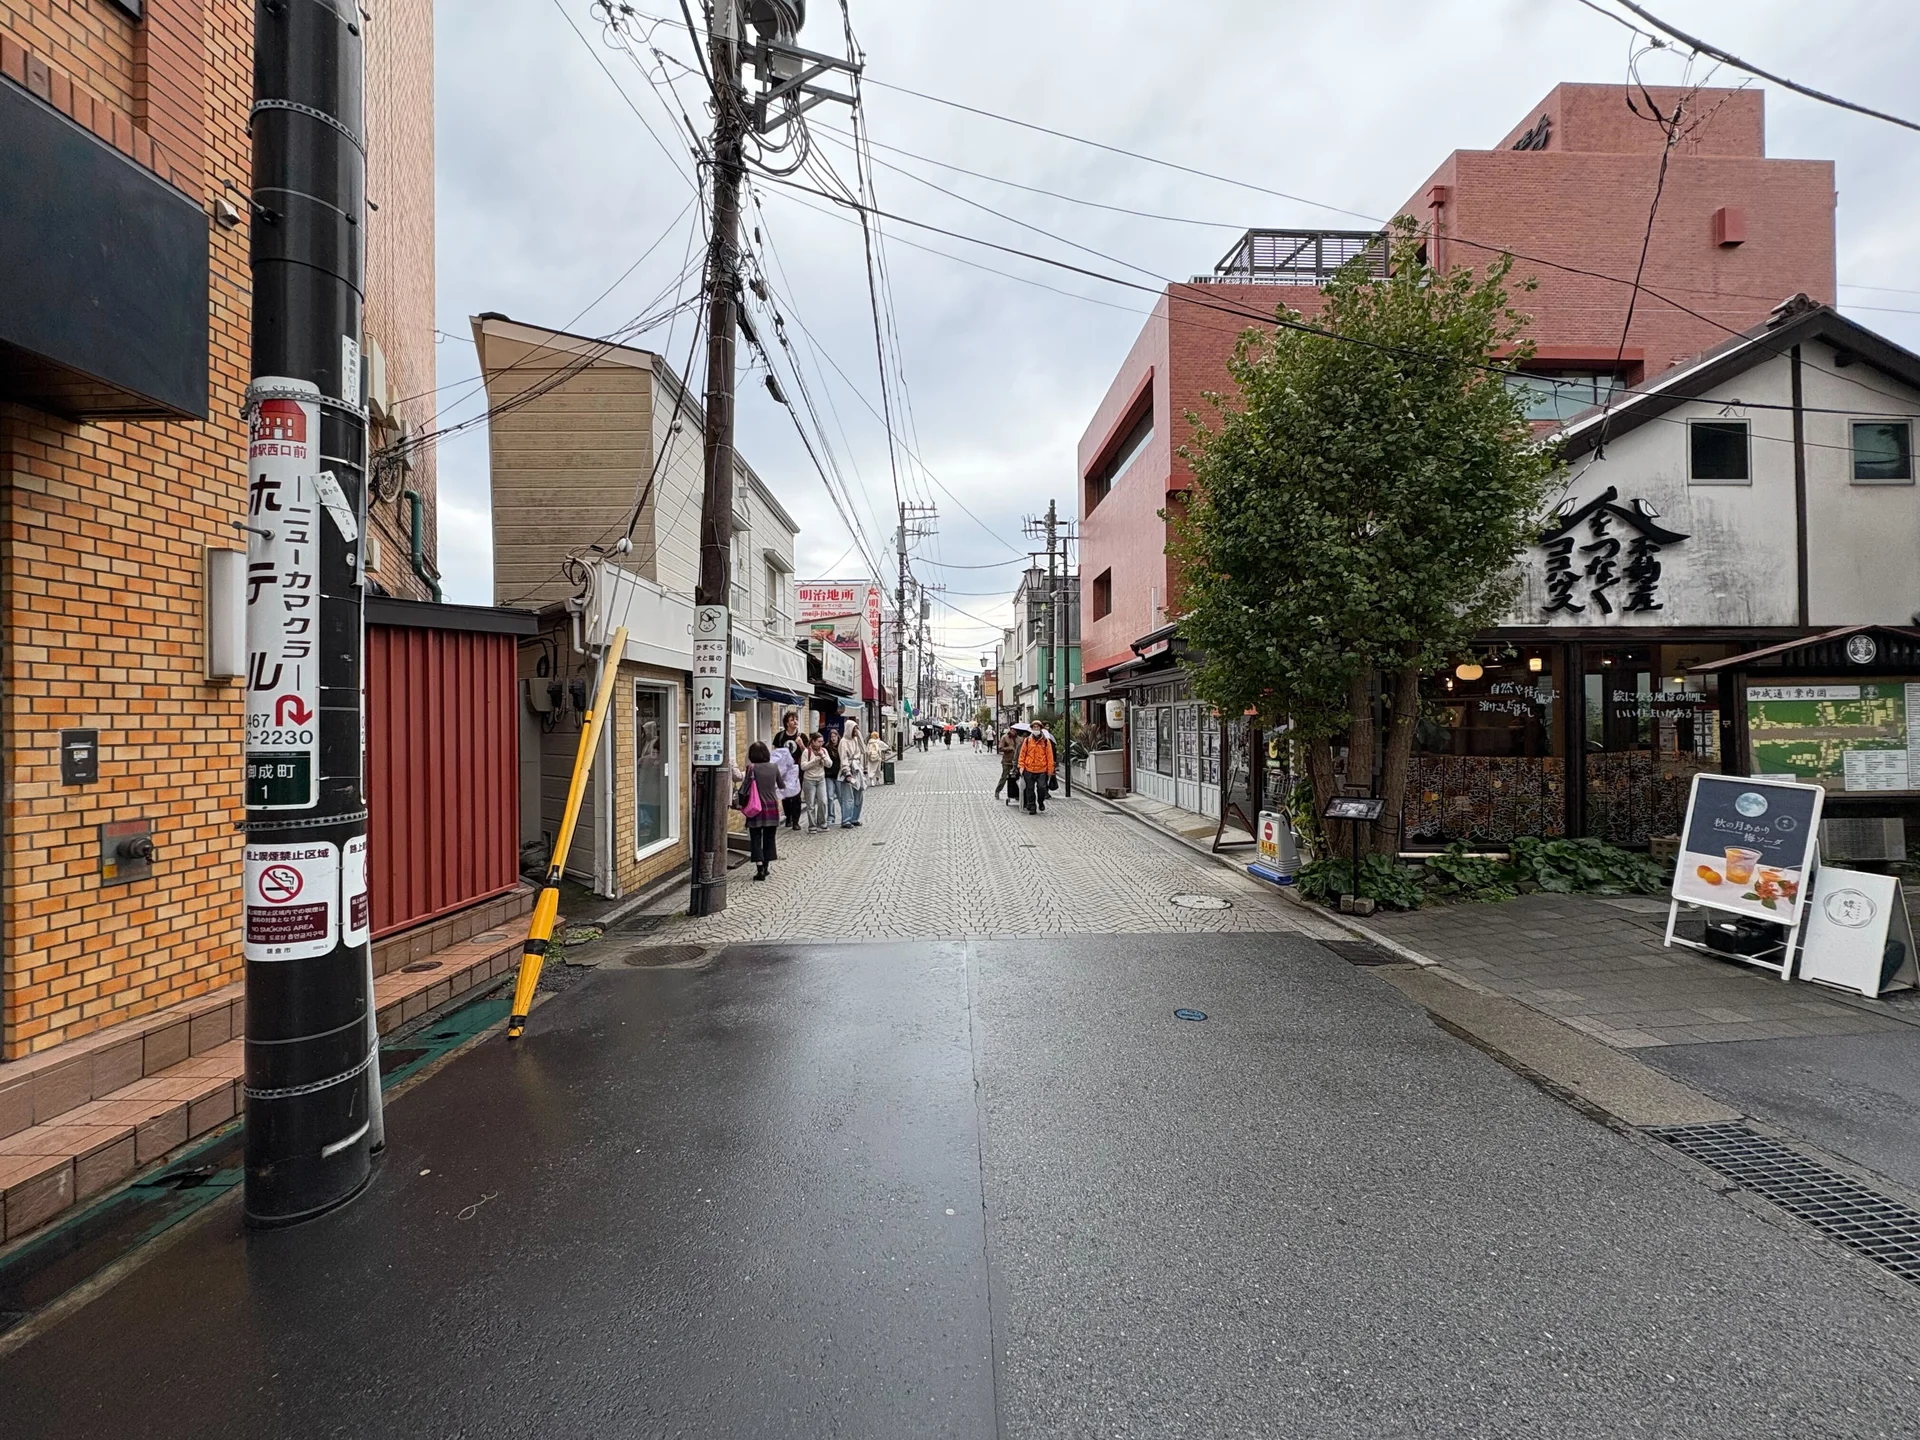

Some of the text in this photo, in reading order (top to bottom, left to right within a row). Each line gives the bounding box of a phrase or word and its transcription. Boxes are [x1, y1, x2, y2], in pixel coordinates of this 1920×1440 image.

[249, 443, 307, 459] 倉駅西口前
[1622, 536, 1663, 612] 不動産
[247, 474, 283, 691] ホテル
[799, 588, 854, 601] 明治地所
[696, 643, 723, 651] かまくら
[700, 666, 718, 674] 病院
[1749, 688, 1827, 699] 御成通り案内図
[246, 714, 270, 728] 467
[246, 730, 313, 745] 2-2230
[247, 763, 296, 779] 御成町
[261, 784, 269, 800] 1
[1714, 817, 1770, 834] 秋の月あかり
[1744, 832, 1784, 846] 梅ソーダ
[260, 925, 291, 933] SMOKING
[293, 923, 314, 931] AREA
